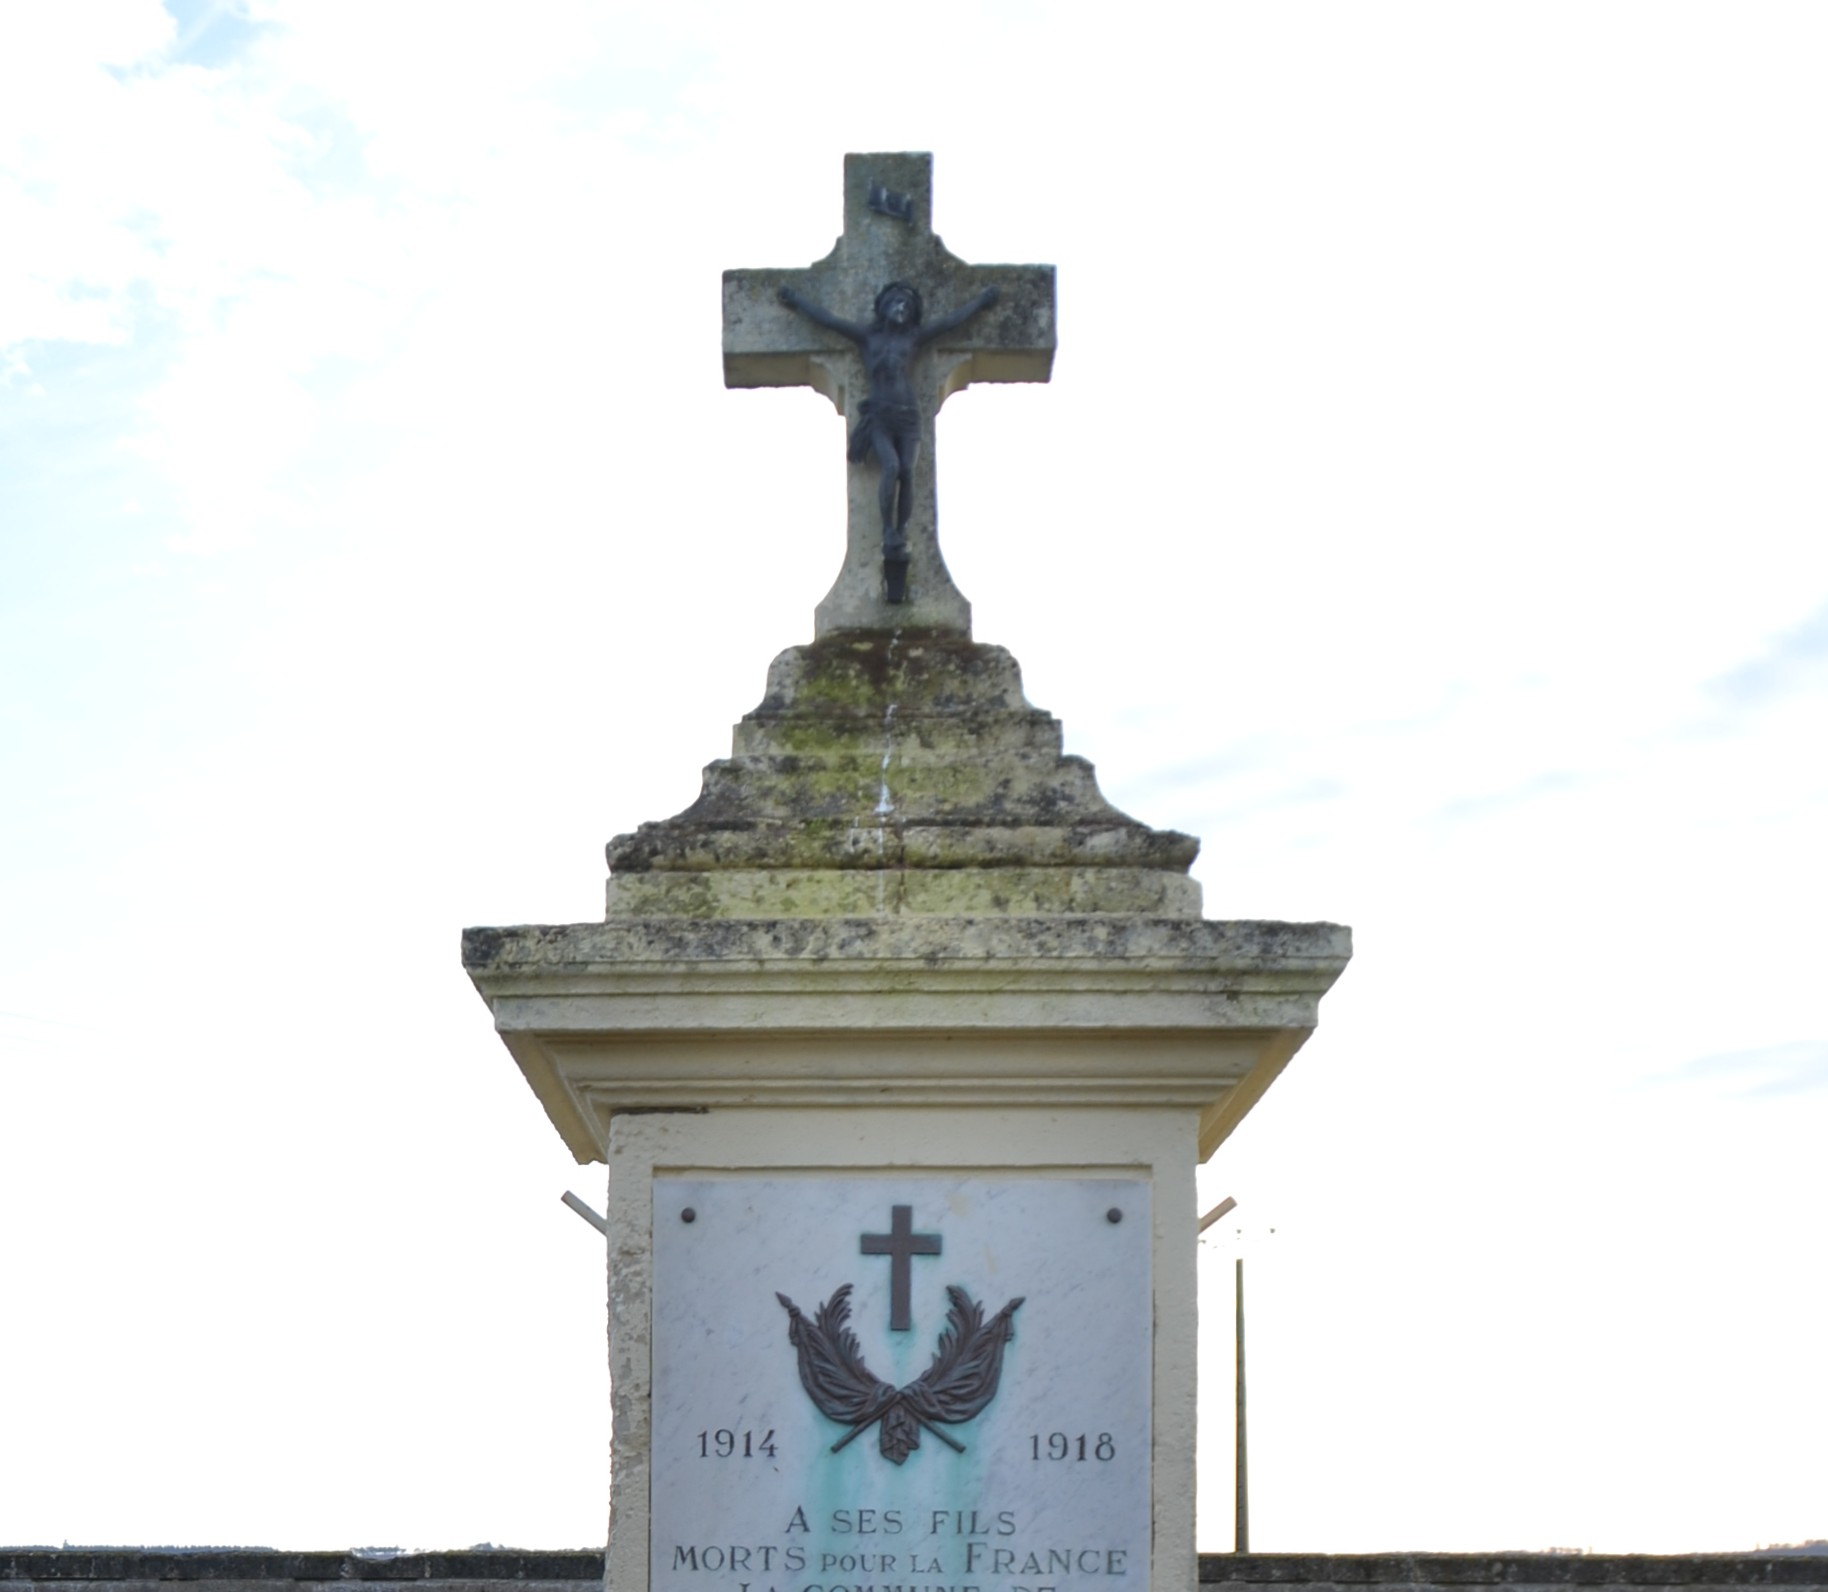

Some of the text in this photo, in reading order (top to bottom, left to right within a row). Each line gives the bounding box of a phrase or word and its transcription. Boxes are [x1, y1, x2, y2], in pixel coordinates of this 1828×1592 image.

[698, 1429, 779, 1458] 1914
[1030, 1433, 1115, 1461] 1918
[785, 1506, 1017, 1535] A SES FILS
[672, 1543, 1128, 1575] MORTS POUR LA FRANCE
